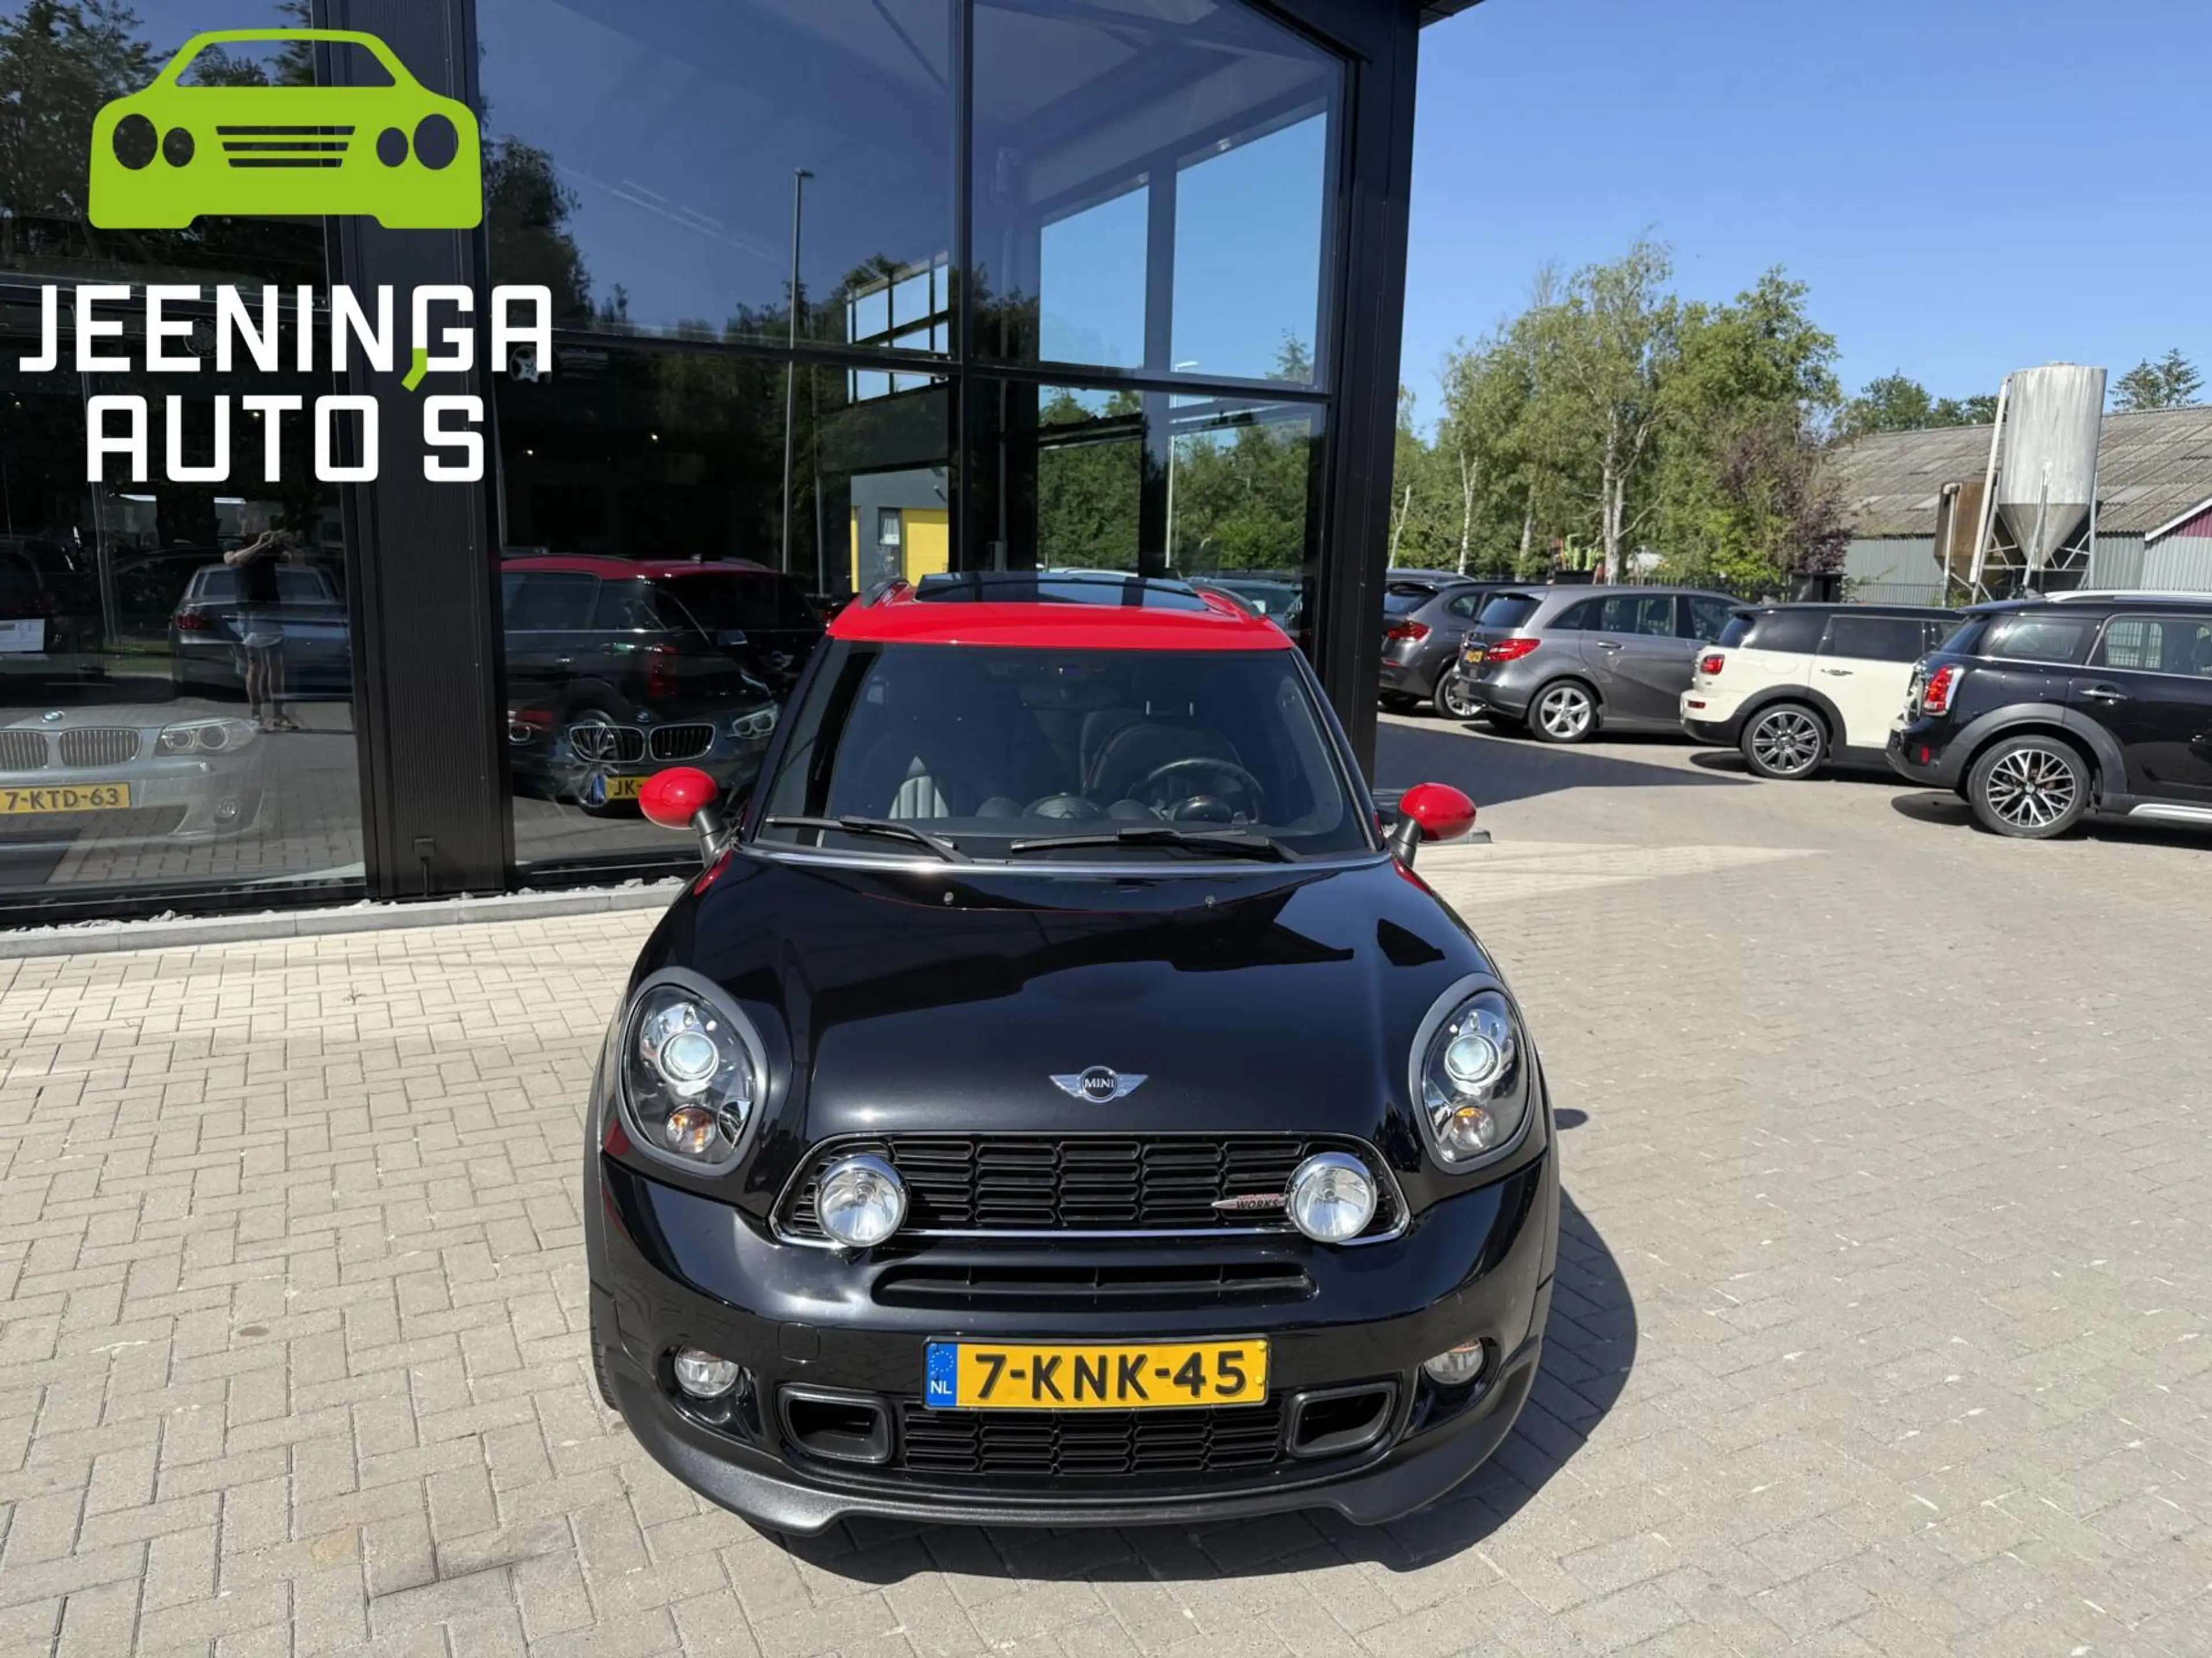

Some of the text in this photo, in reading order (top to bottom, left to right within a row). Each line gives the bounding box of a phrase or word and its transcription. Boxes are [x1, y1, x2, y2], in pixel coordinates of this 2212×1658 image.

[5, 787, 119, 811] 7-KTD-63
[1084, 1077, 1115, 1088] MINI
[1236, 1198, 1279, 1209] WORKS
[930, 1349, 1248, 1402] NL 7-KNK-45
